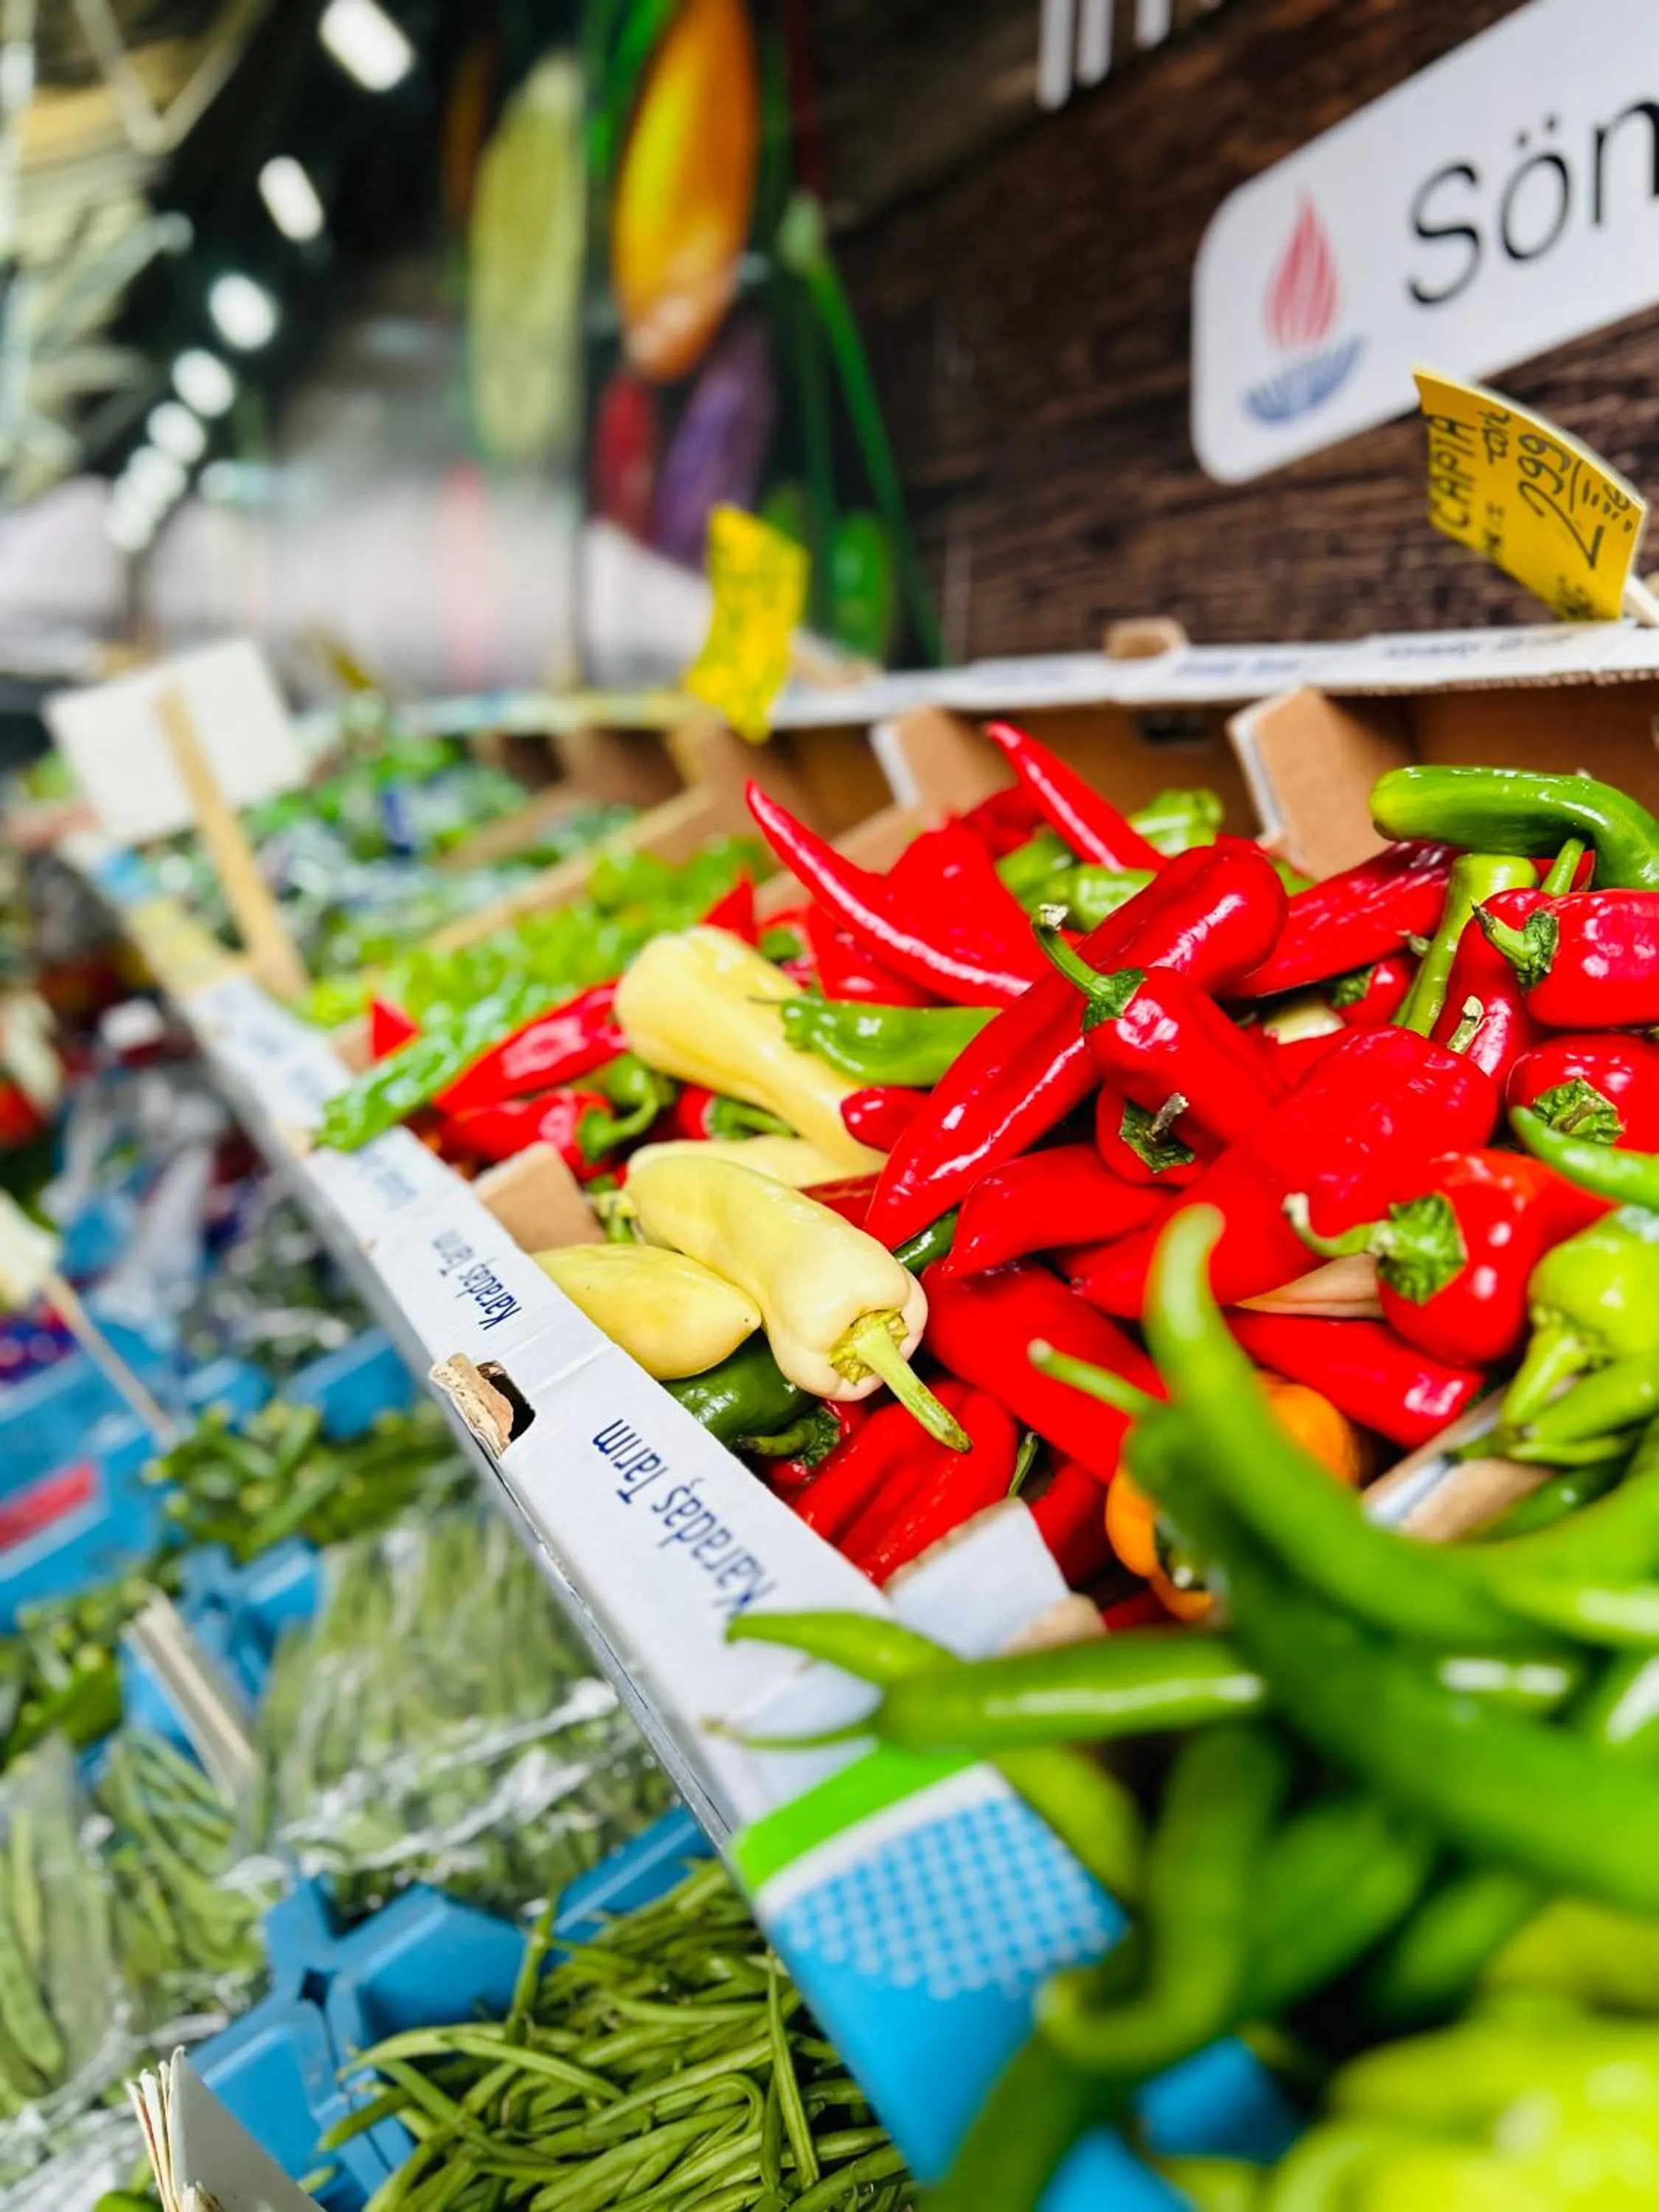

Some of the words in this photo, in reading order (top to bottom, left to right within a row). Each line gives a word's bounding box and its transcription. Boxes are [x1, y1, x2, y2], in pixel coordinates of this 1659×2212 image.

[454, 1255, 523, 1331] Karadaş
[592, 1418, 669, 1505] Tarım
[651, 1476, 779, 1621] Karadaş
